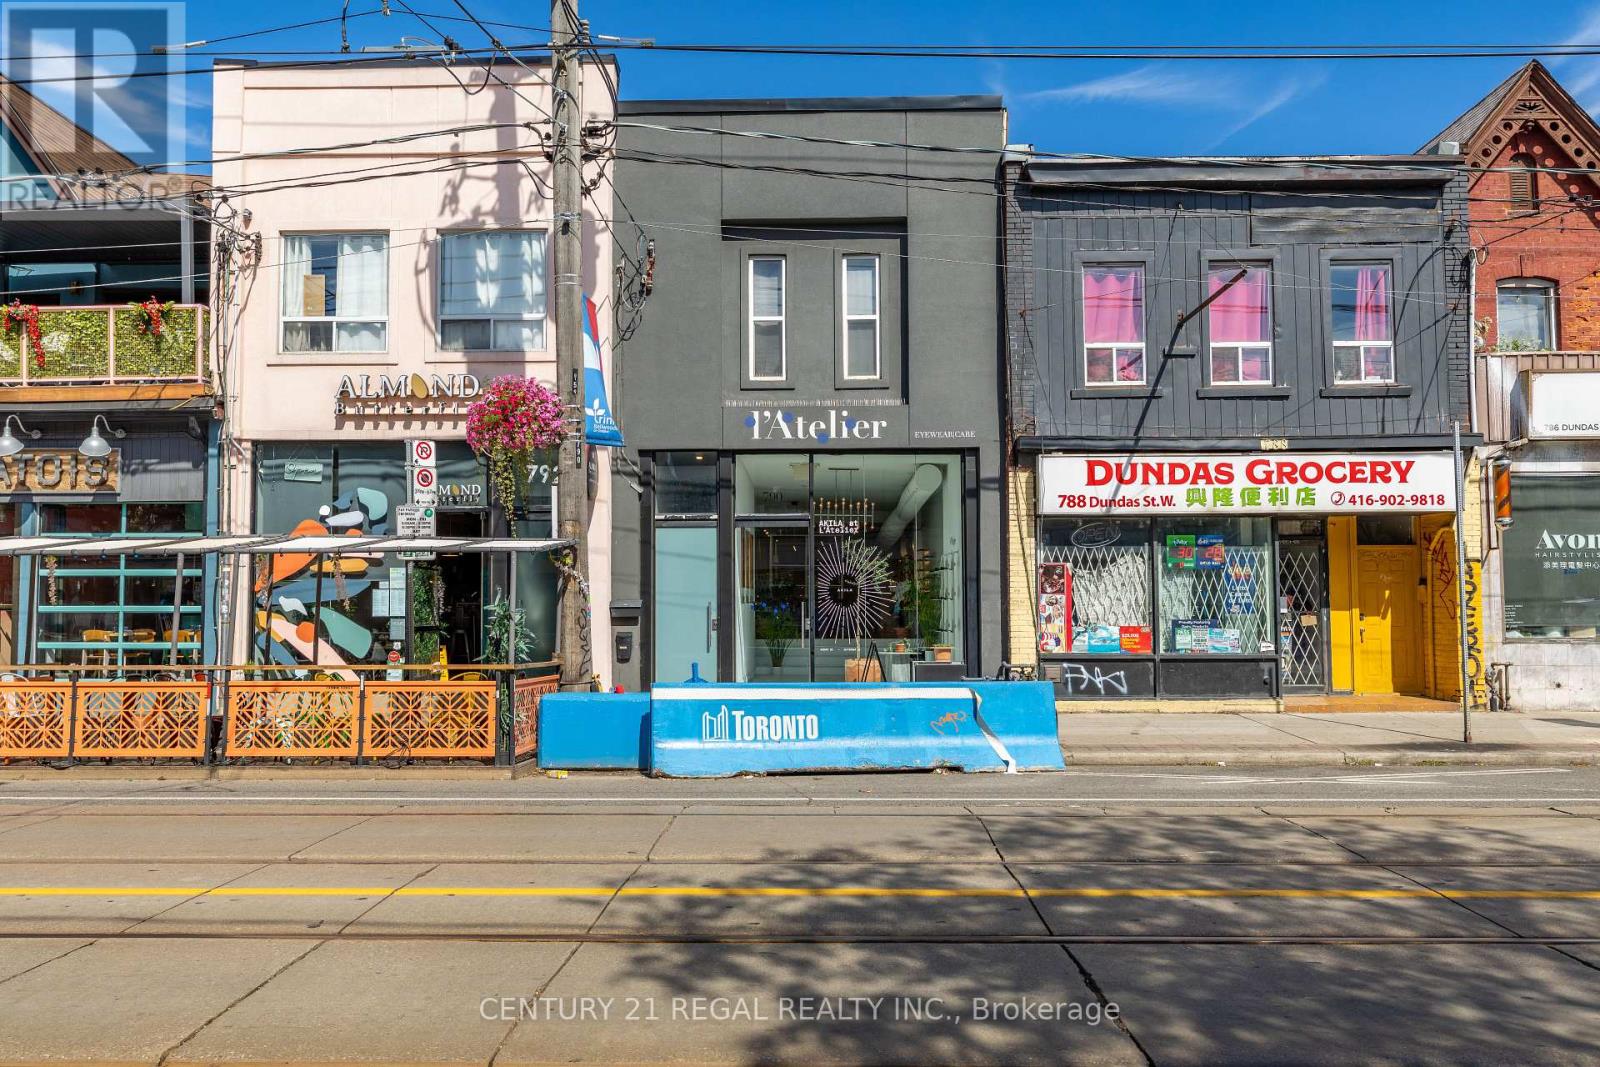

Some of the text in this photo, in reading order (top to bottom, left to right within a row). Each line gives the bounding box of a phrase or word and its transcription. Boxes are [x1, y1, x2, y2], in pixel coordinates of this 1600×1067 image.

[334, 373, 480, 399] ALMOND
[748, 409, 888, 440] l'Atelier
[1561, 423, 1599, 431] DUNDAS
[1084, 458, 1416, 487] DUNDAS GROCERY
[1057, 494, 1087, 508] 788
[1089, 496, 1140, 508] Dundas
[1185, 486, 1316, 508] 興隆便利店
[1347, 493, 1446, 506] 416-902-9818
[732, 709, 819, 741] TORONTO
